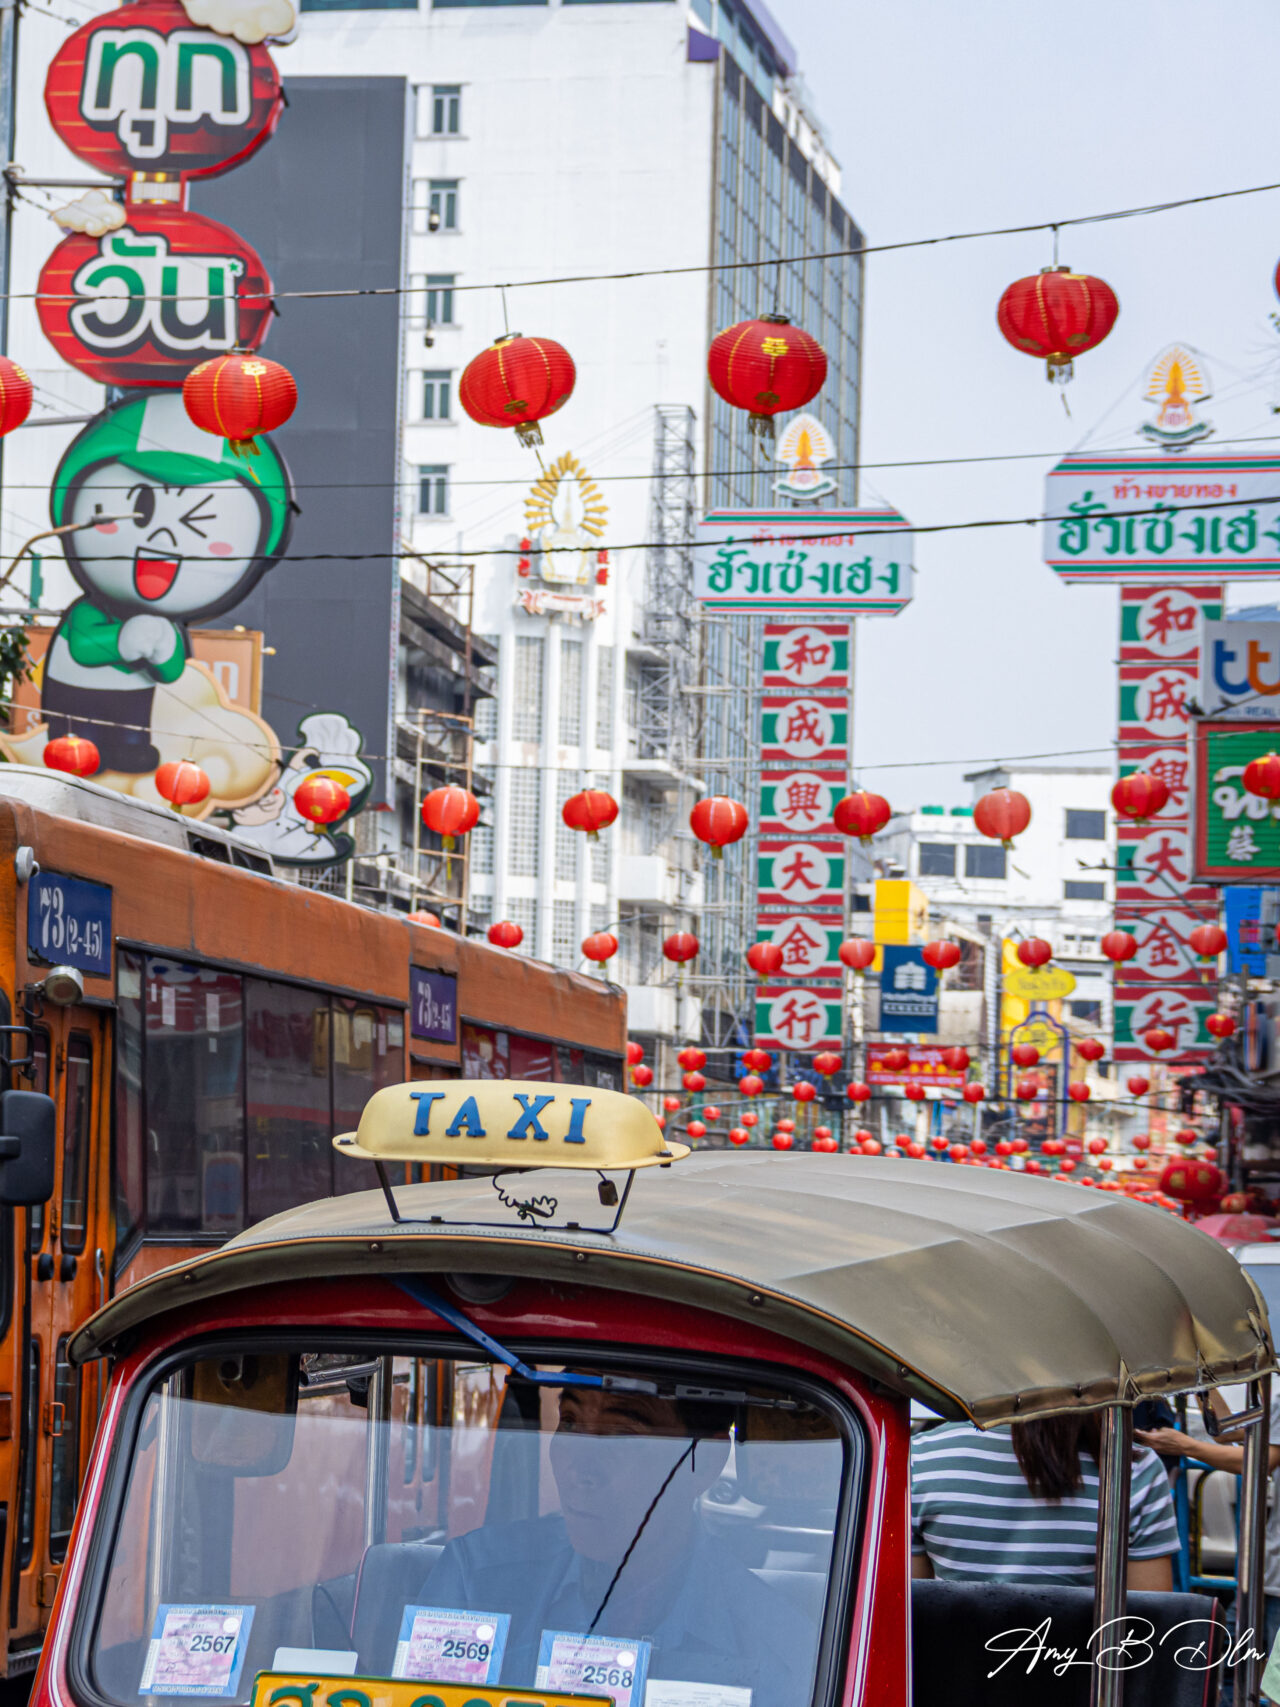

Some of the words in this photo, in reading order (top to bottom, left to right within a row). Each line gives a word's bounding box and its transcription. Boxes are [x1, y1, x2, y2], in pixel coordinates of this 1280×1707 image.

[91, 38, 241, 149] ทุก
[80, 236, 231, 343] วัน
[1113, 478, 1238, 500] ห้างขายทอง
[706, 536, 900, 595] ฮั่วเซ่งเฮง
[410, 1091, 593, 1144] TAXI
[190, 1635, 235, 1654] 2567
[441, 1639, 490, 1662] 2569
[582, 1665, 634, 1688] 2568
